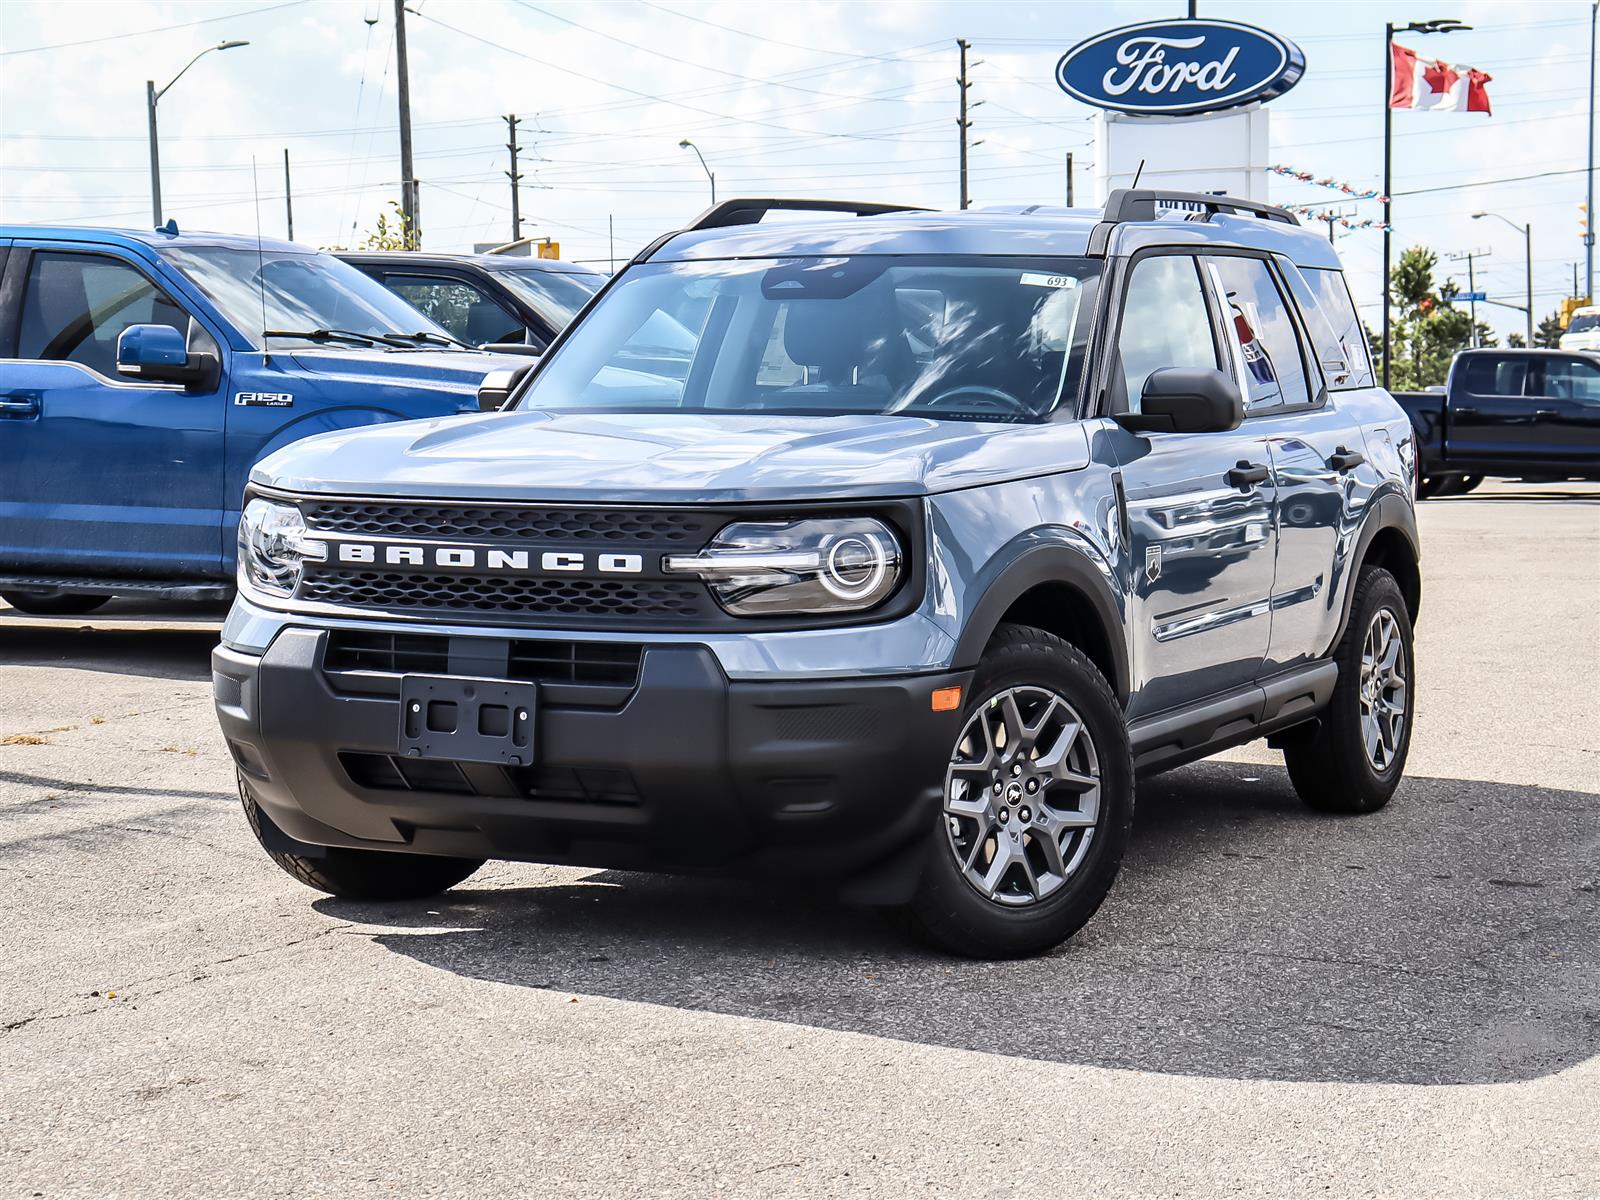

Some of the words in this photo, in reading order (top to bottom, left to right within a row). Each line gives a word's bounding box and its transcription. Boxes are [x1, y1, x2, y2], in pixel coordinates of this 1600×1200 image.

[1103, 36, 1240, 96] Ford
[1047, 276, 1068, 287] 693
[339, 543, 643, 572] BRONCO
